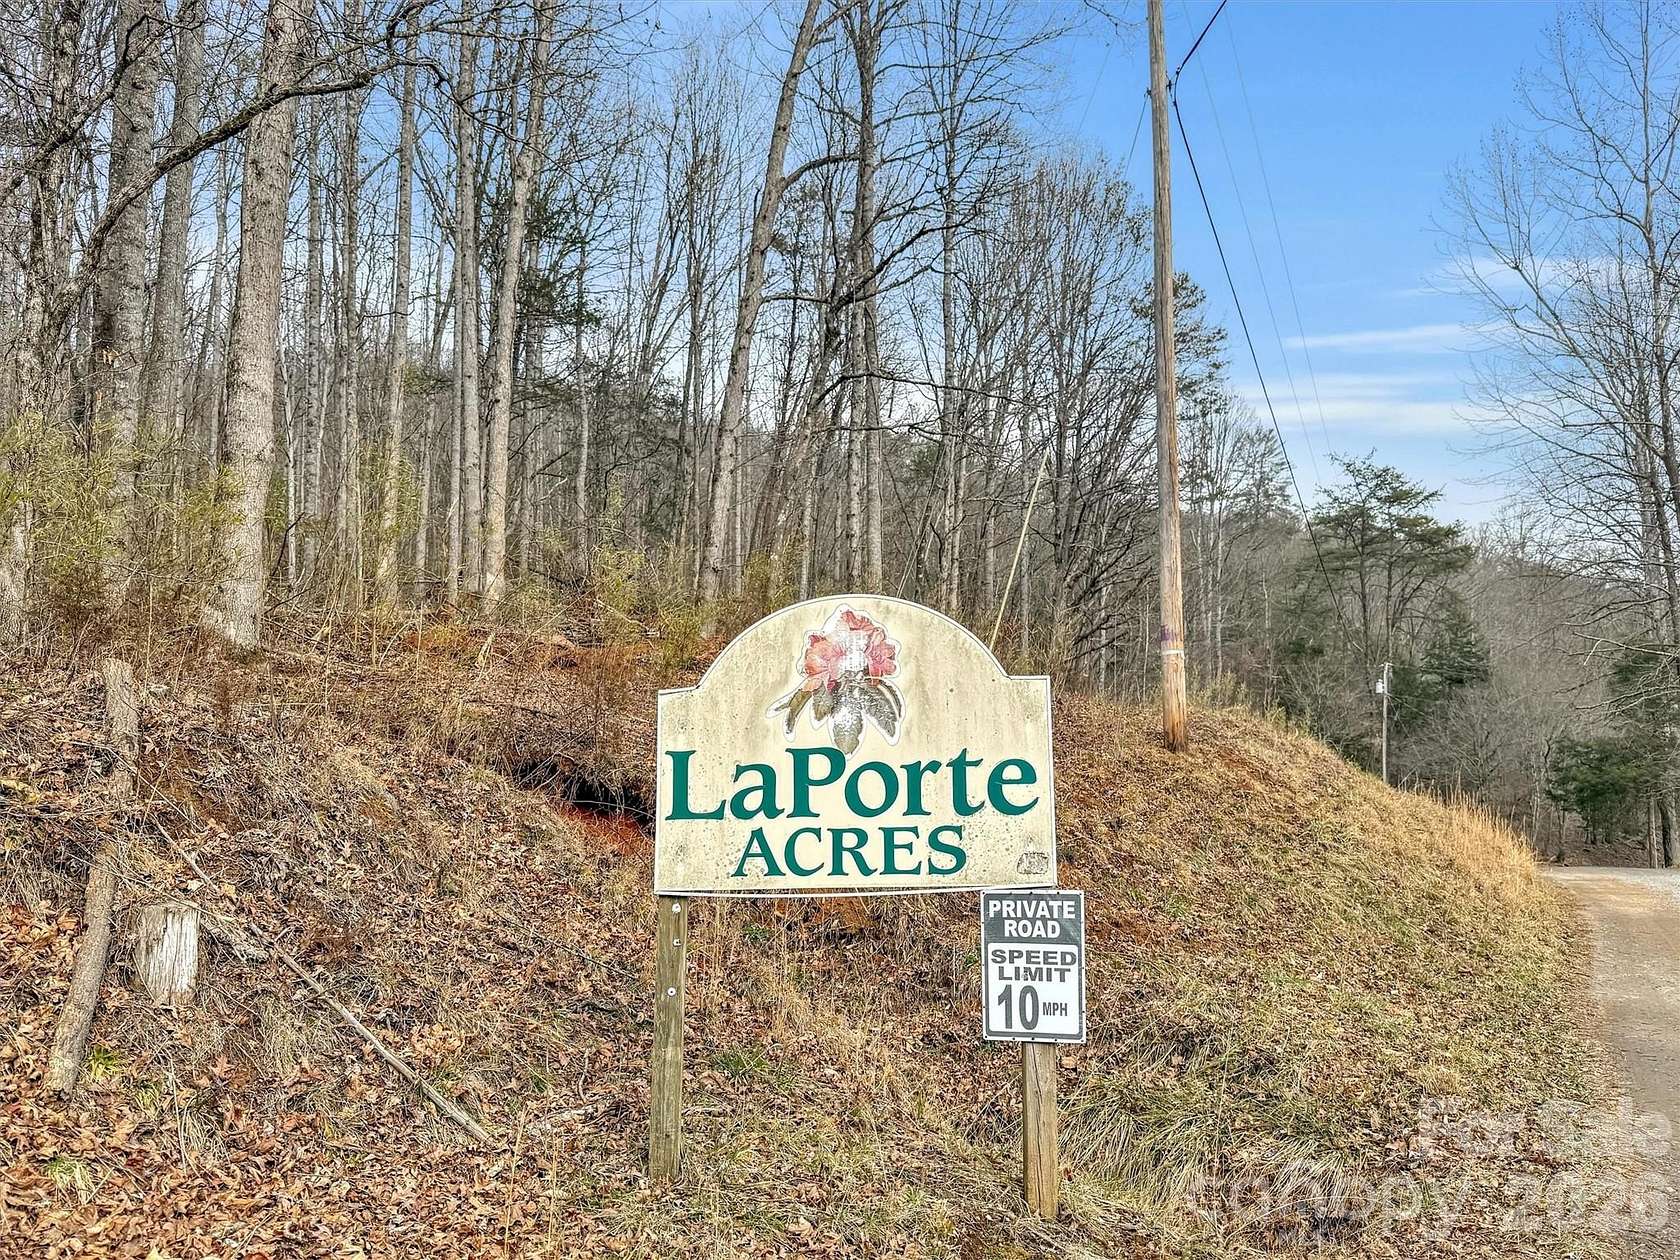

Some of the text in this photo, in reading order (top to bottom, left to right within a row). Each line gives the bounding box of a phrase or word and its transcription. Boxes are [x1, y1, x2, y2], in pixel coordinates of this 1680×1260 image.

[665, 748, 1039, 820] LaPorte
[732, 826, 967, 877] ACRES
[988, 900, 1076, 918] PRIVATE
[1004, 920, 1061, 938] ROAD
[991, 949, 1077, 966] SPEED
[998, 966, 1071, 982] LIMIT
[998, 984, 1068, 1030] 10 MPH
